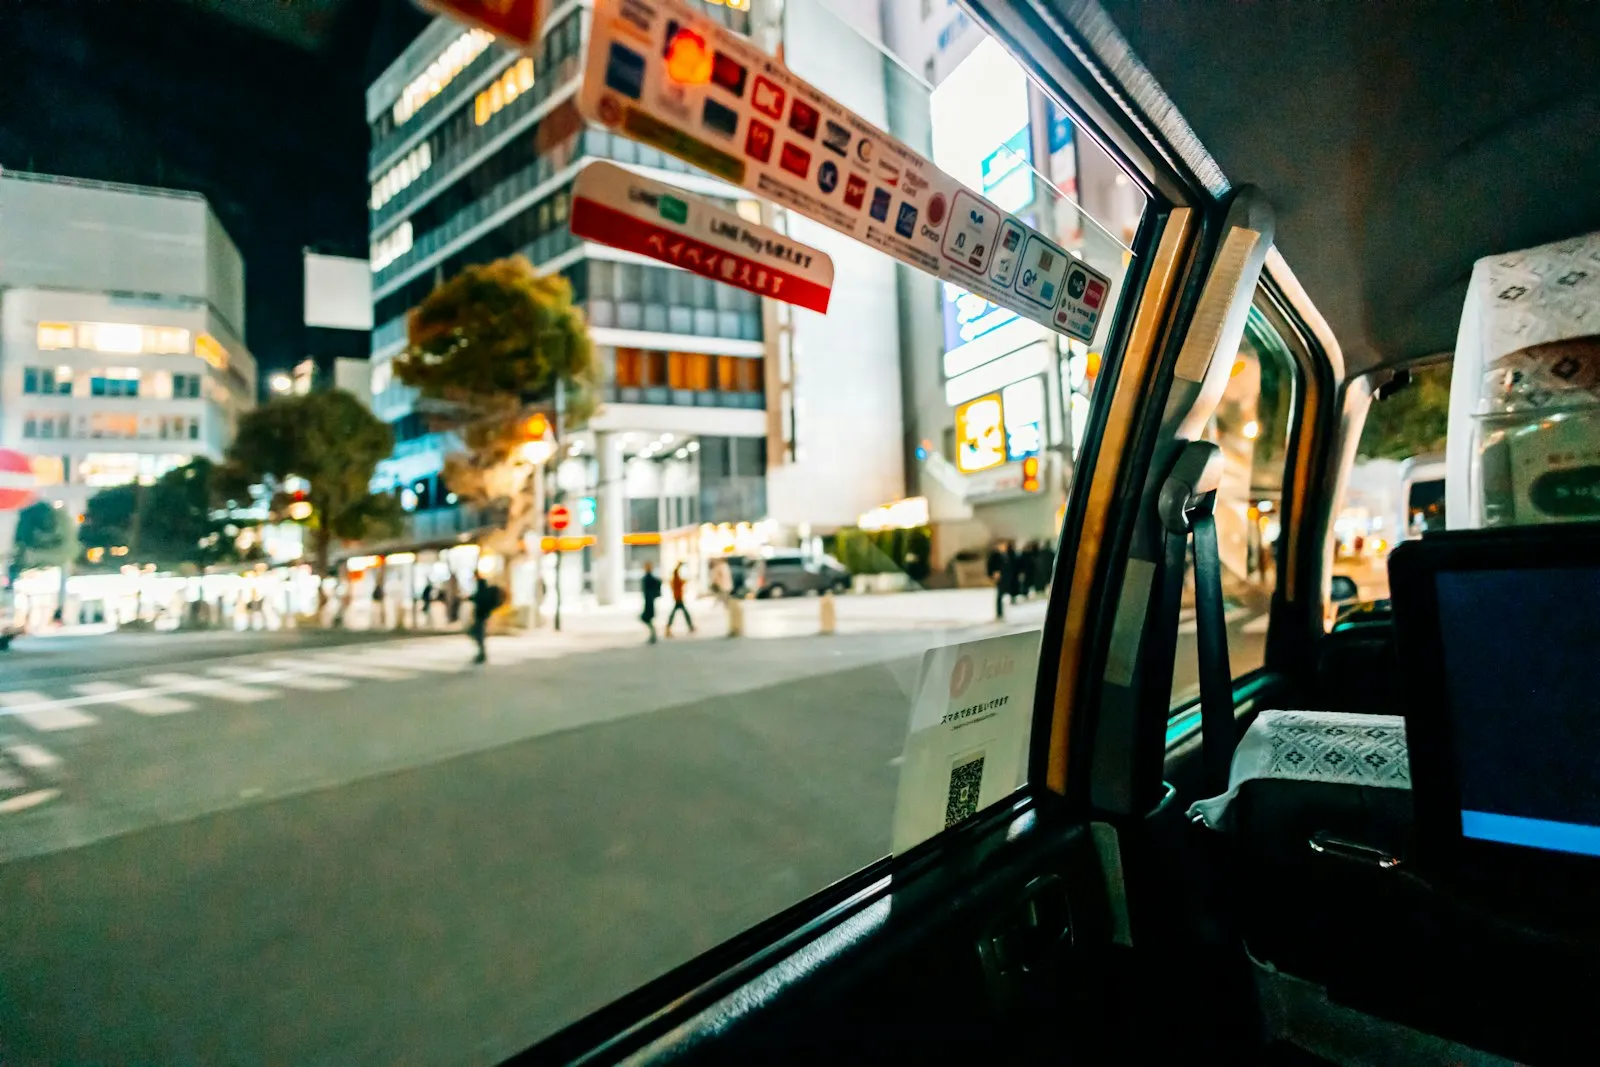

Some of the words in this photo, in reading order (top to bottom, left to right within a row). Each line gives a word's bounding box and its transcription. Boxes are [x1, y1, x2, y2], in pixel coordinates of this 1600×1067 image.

[940, 696, 1009, 725] スマホでお支払いできます
